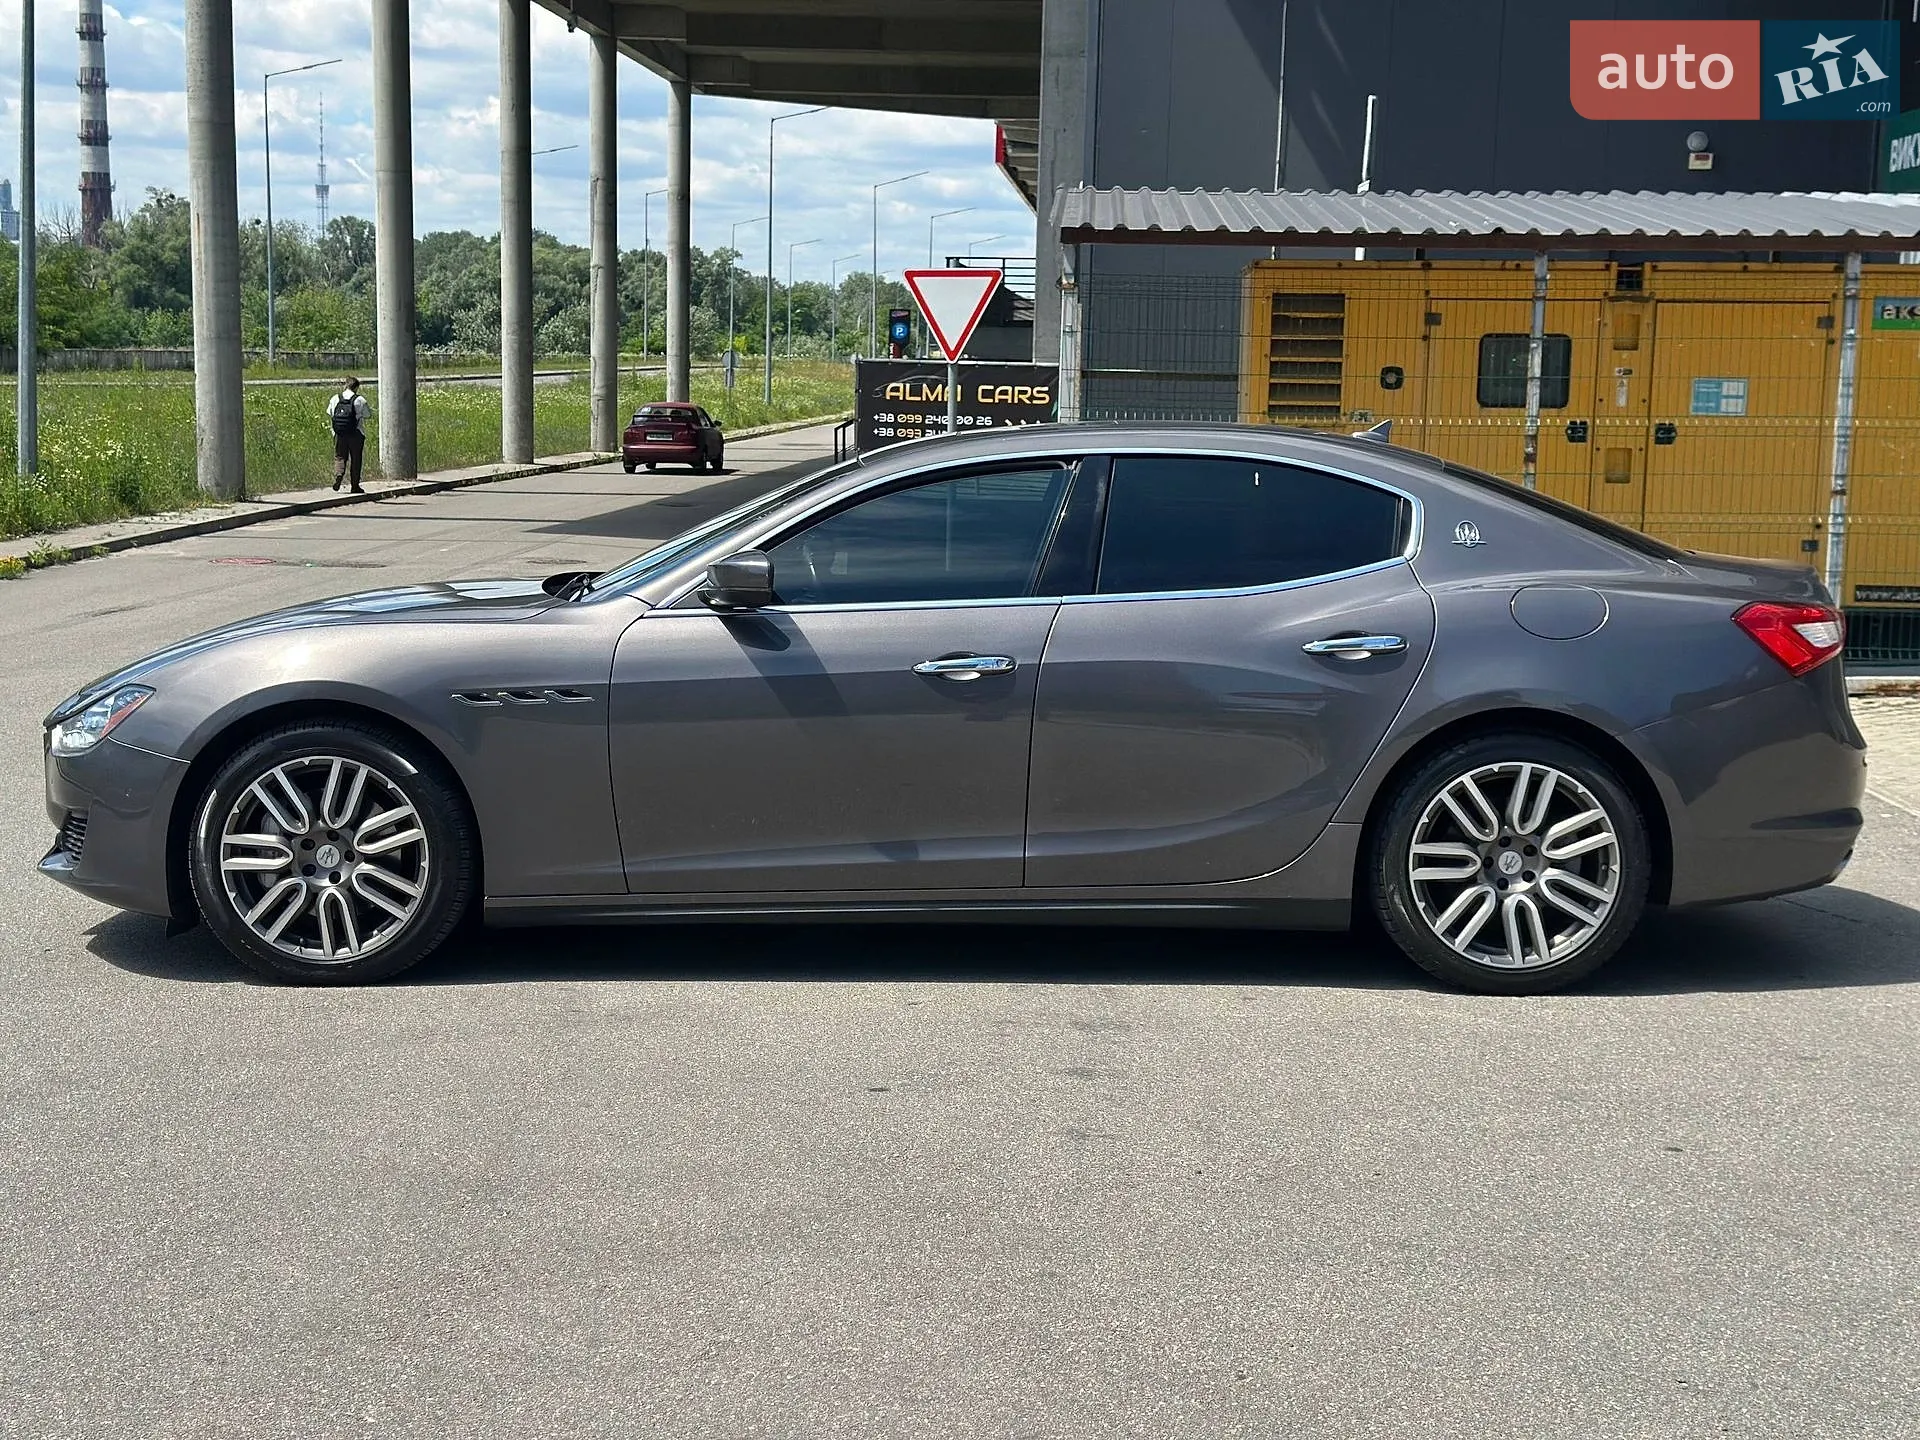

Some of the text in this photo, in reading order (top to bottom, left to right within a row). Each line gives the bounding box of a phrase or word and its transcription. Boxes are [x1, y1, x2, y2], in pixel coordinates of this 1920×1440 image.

[977, 385, 1050, 404] CARS
[873, 413, 894, 422] +38
[897, 414, 922, 423] 099
[976, 416, 992, 426] 26
[873, 427, 894, 436] +38
[897, 428, 921, 438] 093
